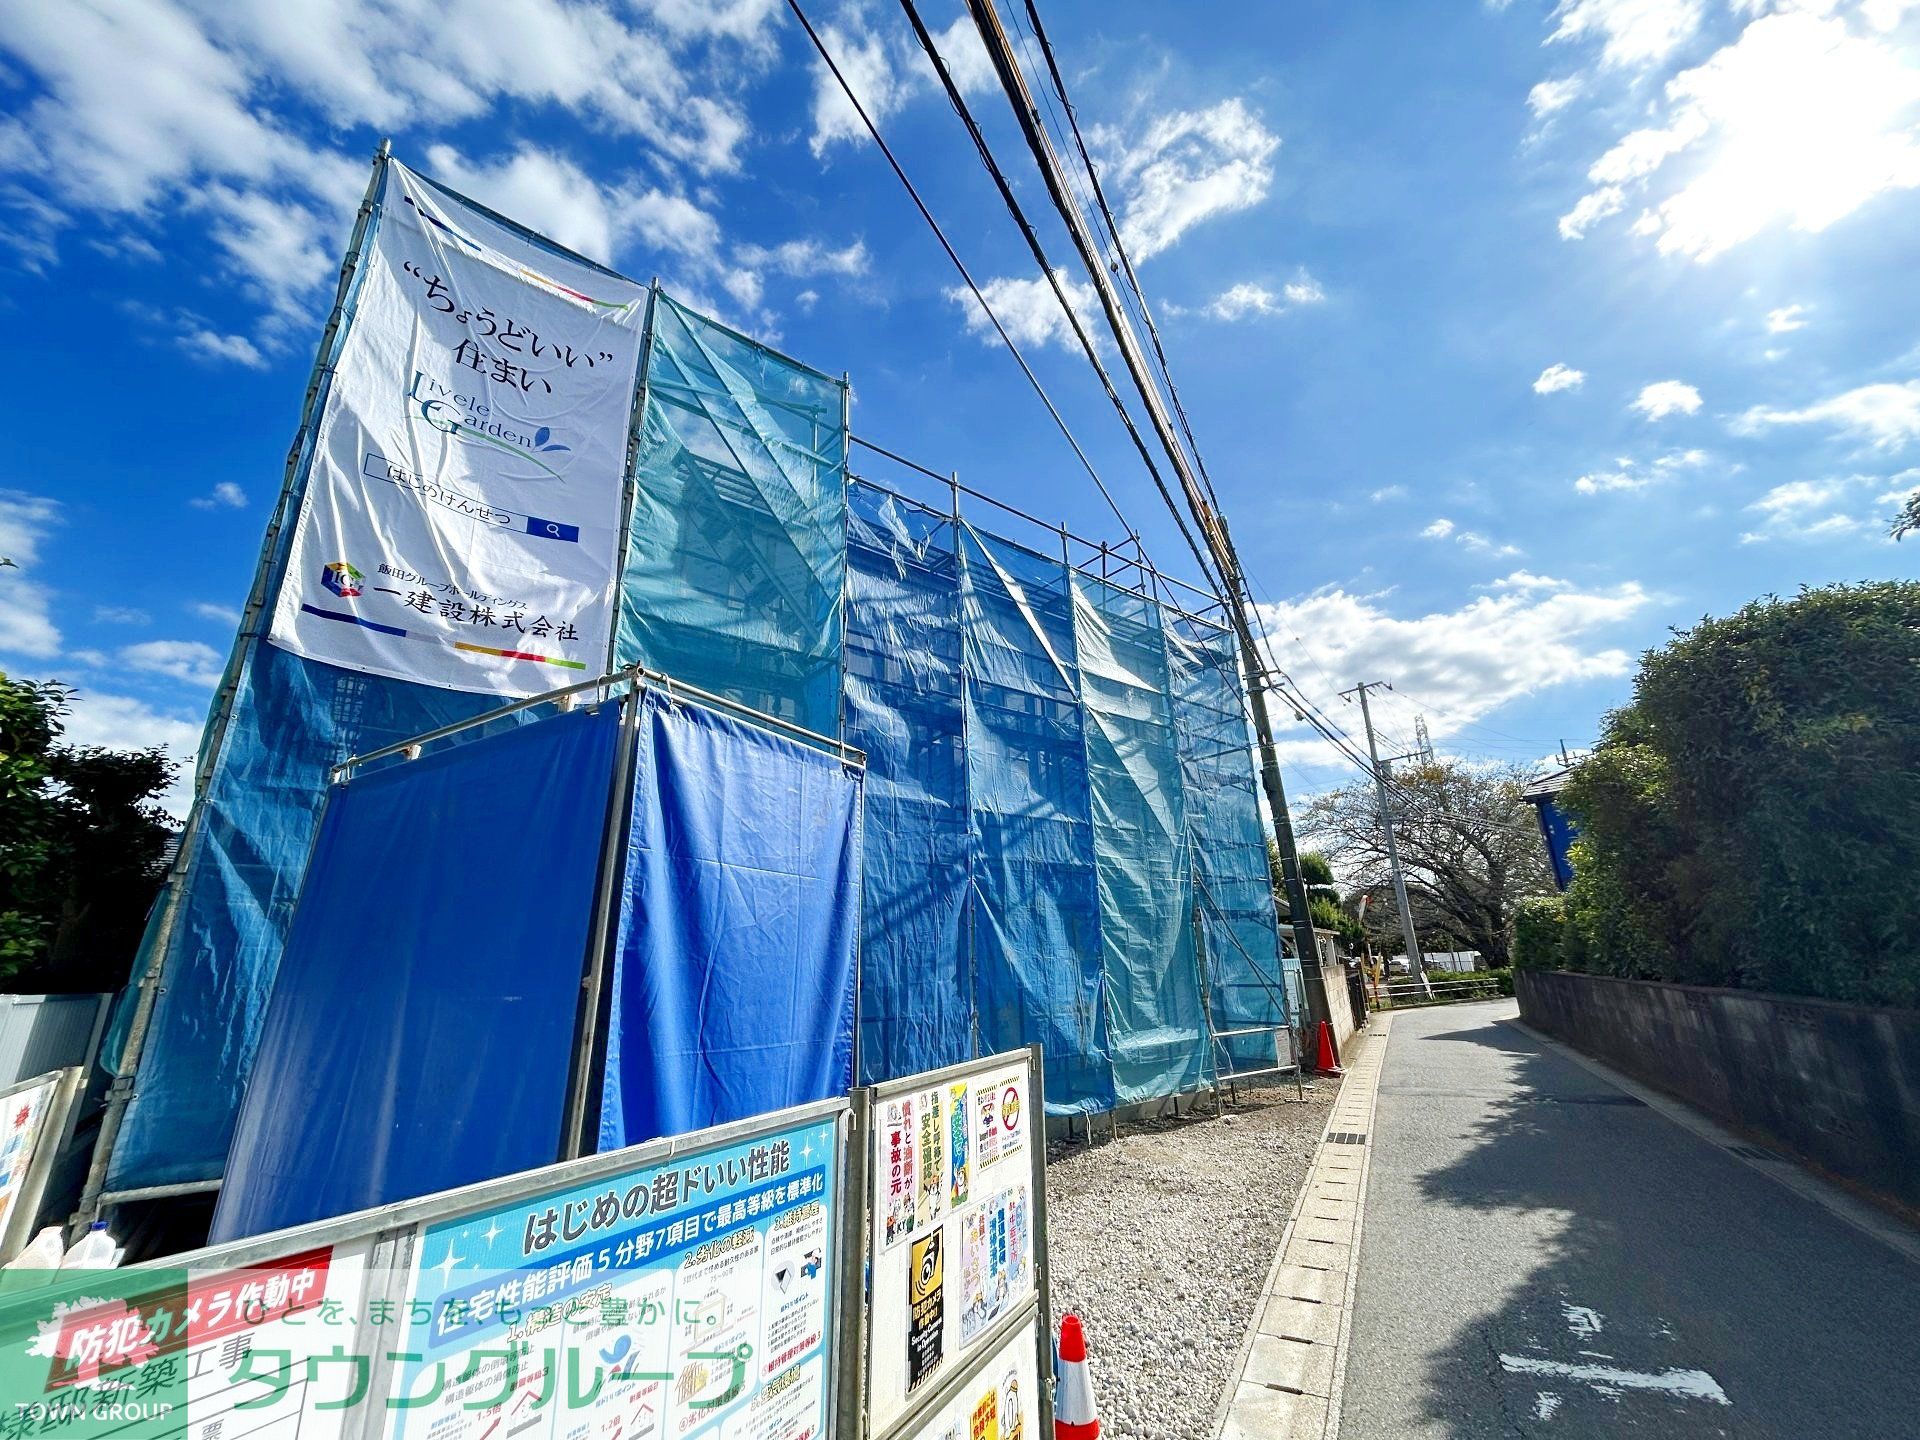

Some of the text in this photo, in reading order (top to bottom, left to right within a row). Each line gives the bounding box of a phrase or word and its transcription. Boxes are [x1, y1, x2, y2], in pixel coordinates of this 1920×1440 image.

[452, 338, 552, 393] 住まい
[407, 370, 491, 417] Livele
[420, 399, 532, 448] Garden
[386, 464, 511, 524] はじめけんせつ
[373, 586, 579, 641] 一建設株式会社
[890, 1130, 902, 1196] 事故の元
[523, 1139, 791, 1255] はじめの超ドいい性能
[65, 1267, 315, 1371] 防犯カメラ作動中
[912, 1288, 942, 1321] 防犯カメラ
